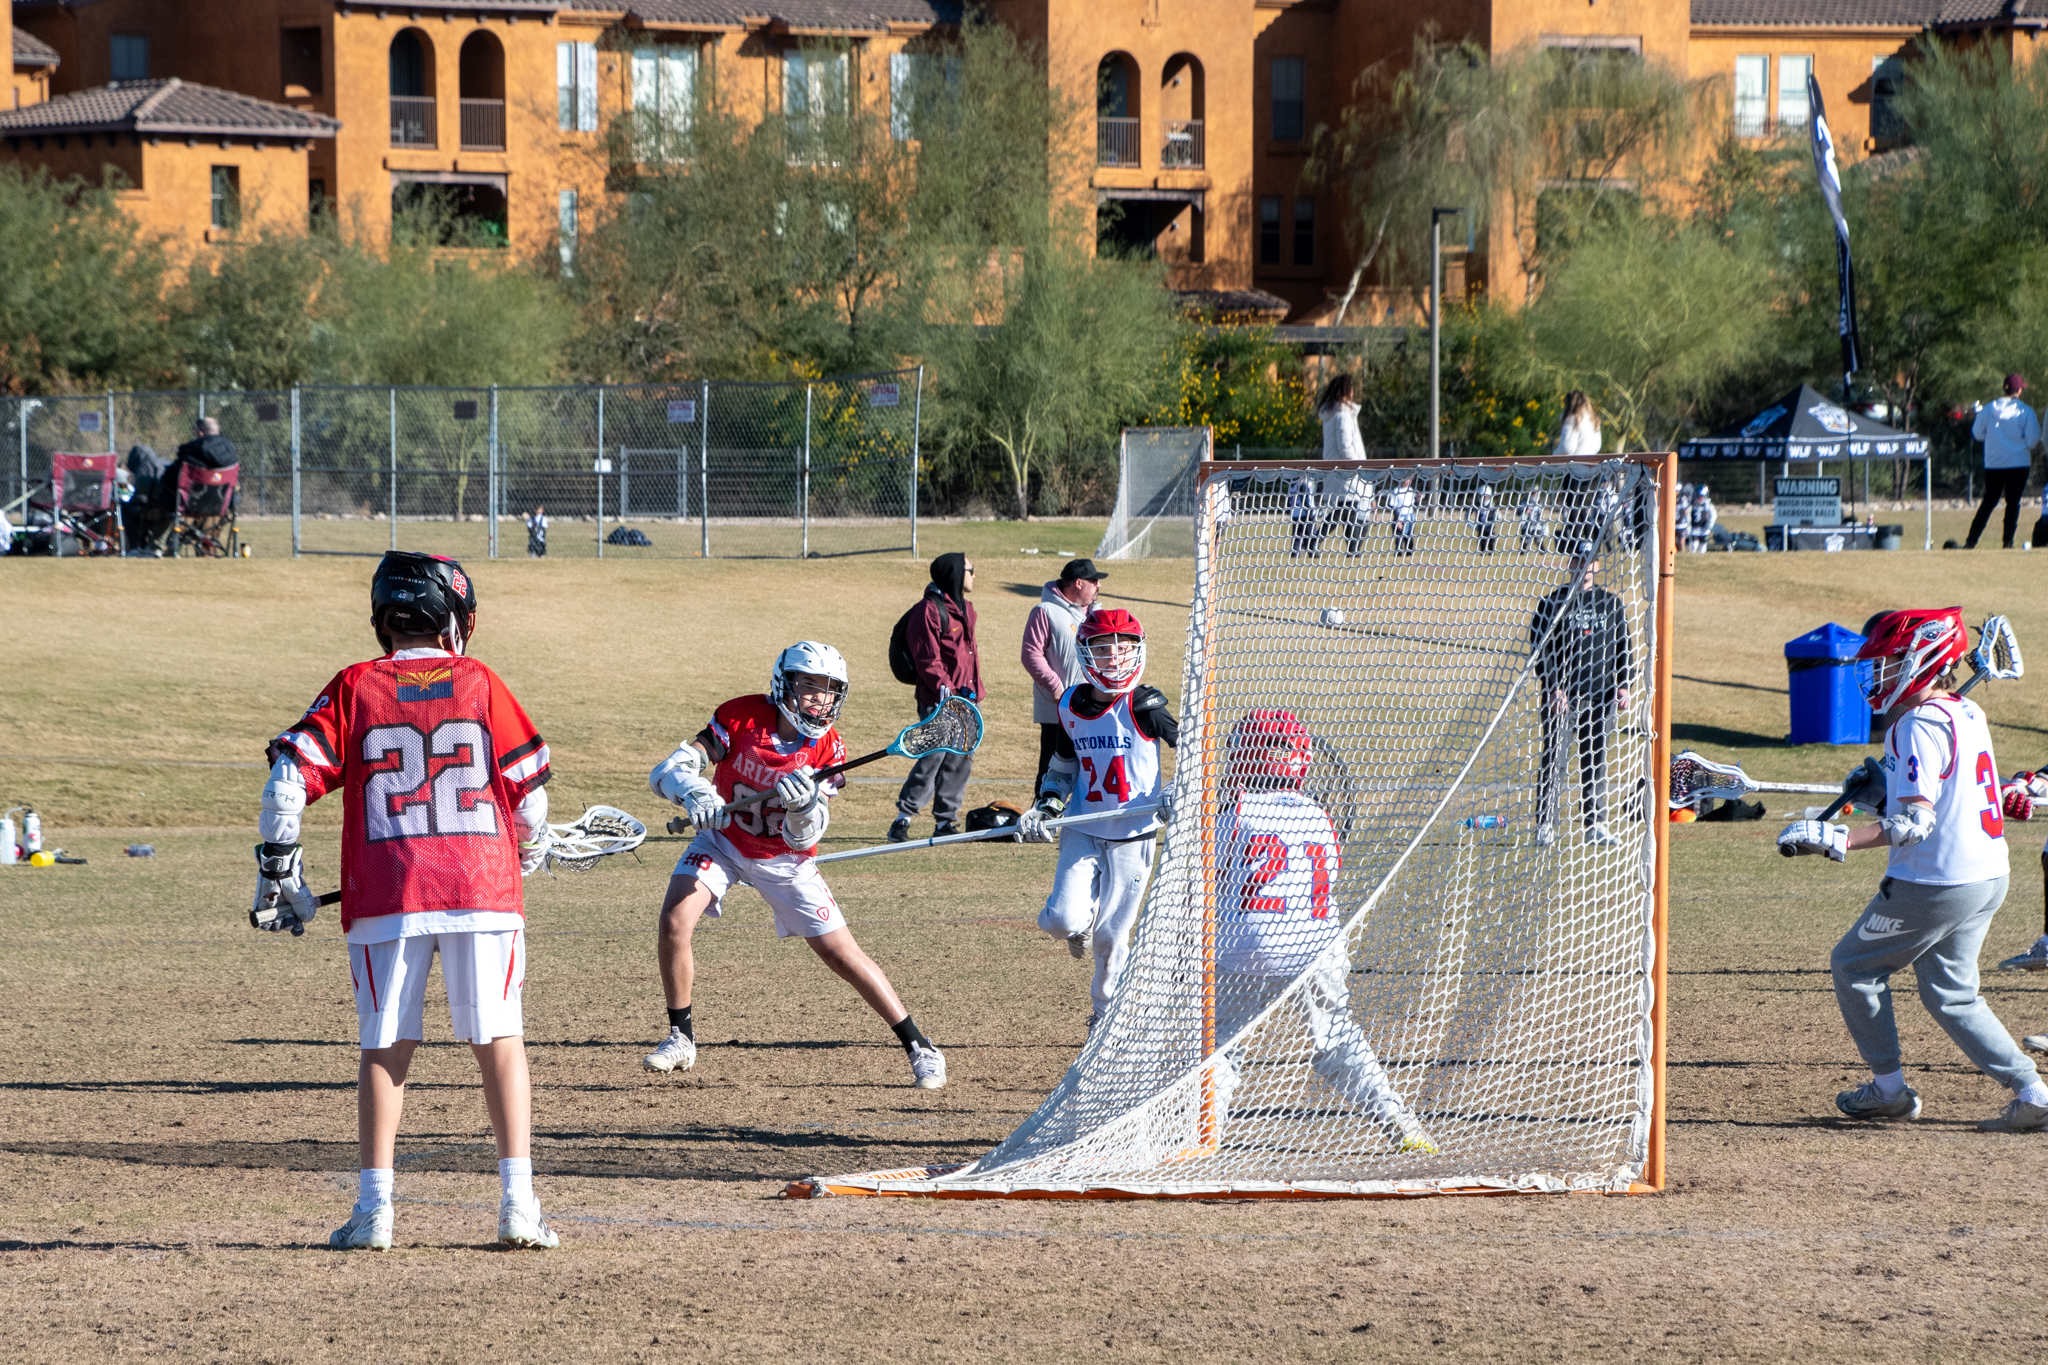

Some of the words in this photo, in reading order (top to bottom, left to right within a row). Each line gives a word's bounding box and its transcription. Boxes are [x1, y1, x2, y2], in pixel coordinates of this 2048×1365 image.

[1788, 445, 1811, 459] WLF
[1817, 443, 1841, 457] WLF
[1847, 442, 1870, 456] WLF
[1876, 442, 1899, 456] WLF
[1905, 440, 1928, 455] WLF
[1776, 479, 1838, 495] WARNING
[1777, 508, 1813, 518] LACROSSE
[1815, 508, 1837, 518] BALLS
[408, 577, 426, 585] EIGHT
[452, 569, 467, 599] 22
[1074, 735, 1132, 751] ATONALS
[1081, 755, 1132, 803] 24
[1907, 754, 1919, 783] 3
[361, 718, 500, 846] 22
[1975, 750, 2004, 840] 3
[1239, 833, 1331, 921] 21
[1865, 912, 1905, 933] NIKE
